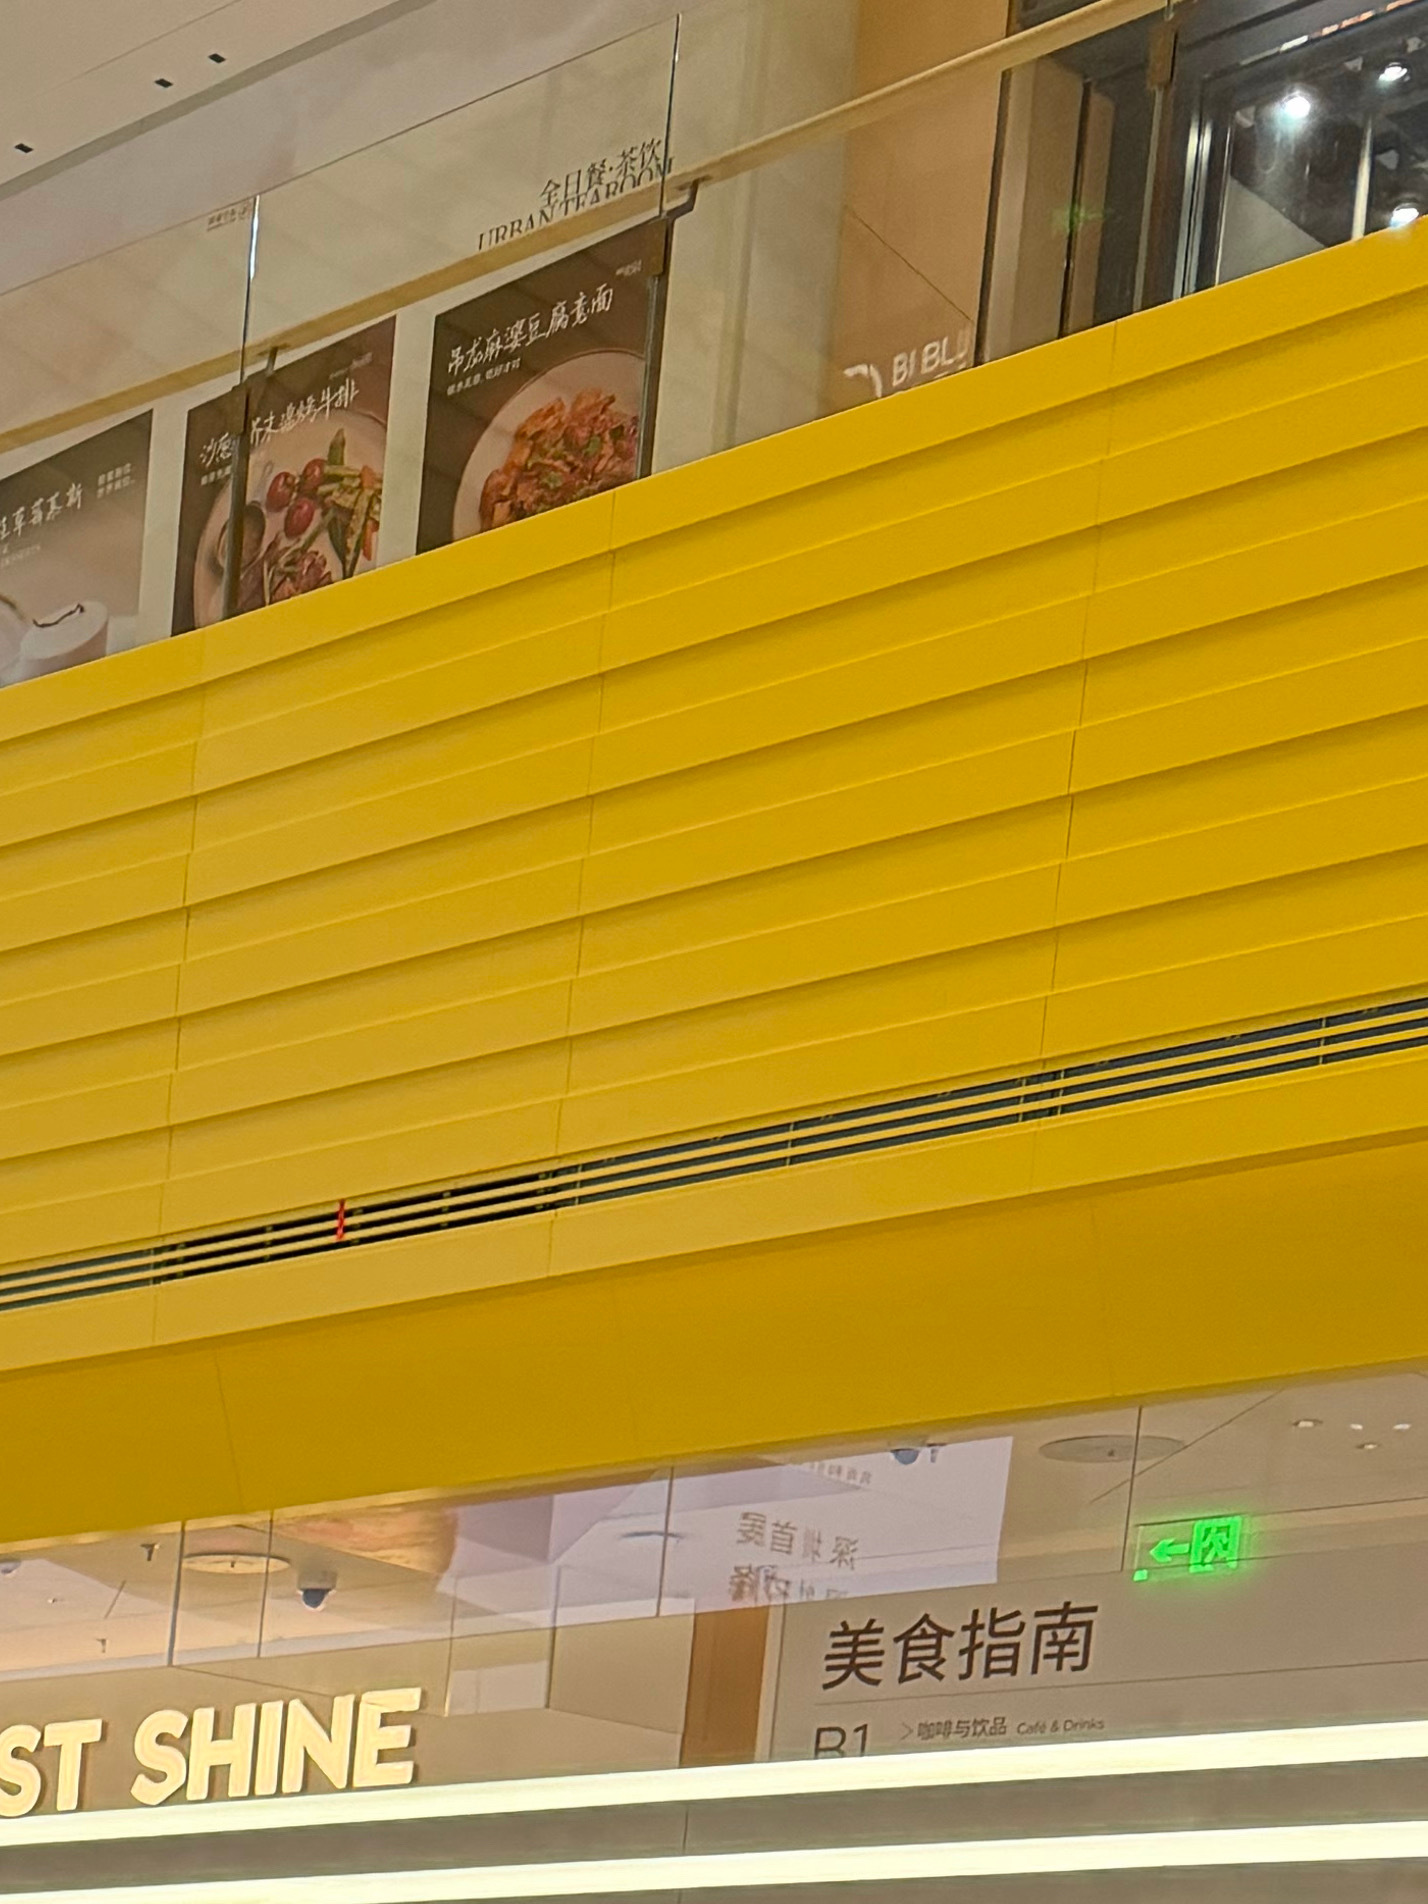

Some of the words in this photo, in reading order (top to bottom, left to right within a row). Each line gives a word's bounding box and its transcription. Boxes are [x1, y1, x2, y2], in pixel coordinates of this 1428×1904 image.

[821, 1600, 1099, 1691] 美食指南
[132, 1686, 425, 1808] SHINE
[916, 1717, 1008, 1742] 咖啡与饮品
[1017, 1720, 1048, 1737] Café
[1063, 1718, 1105, 1732] Drinks
